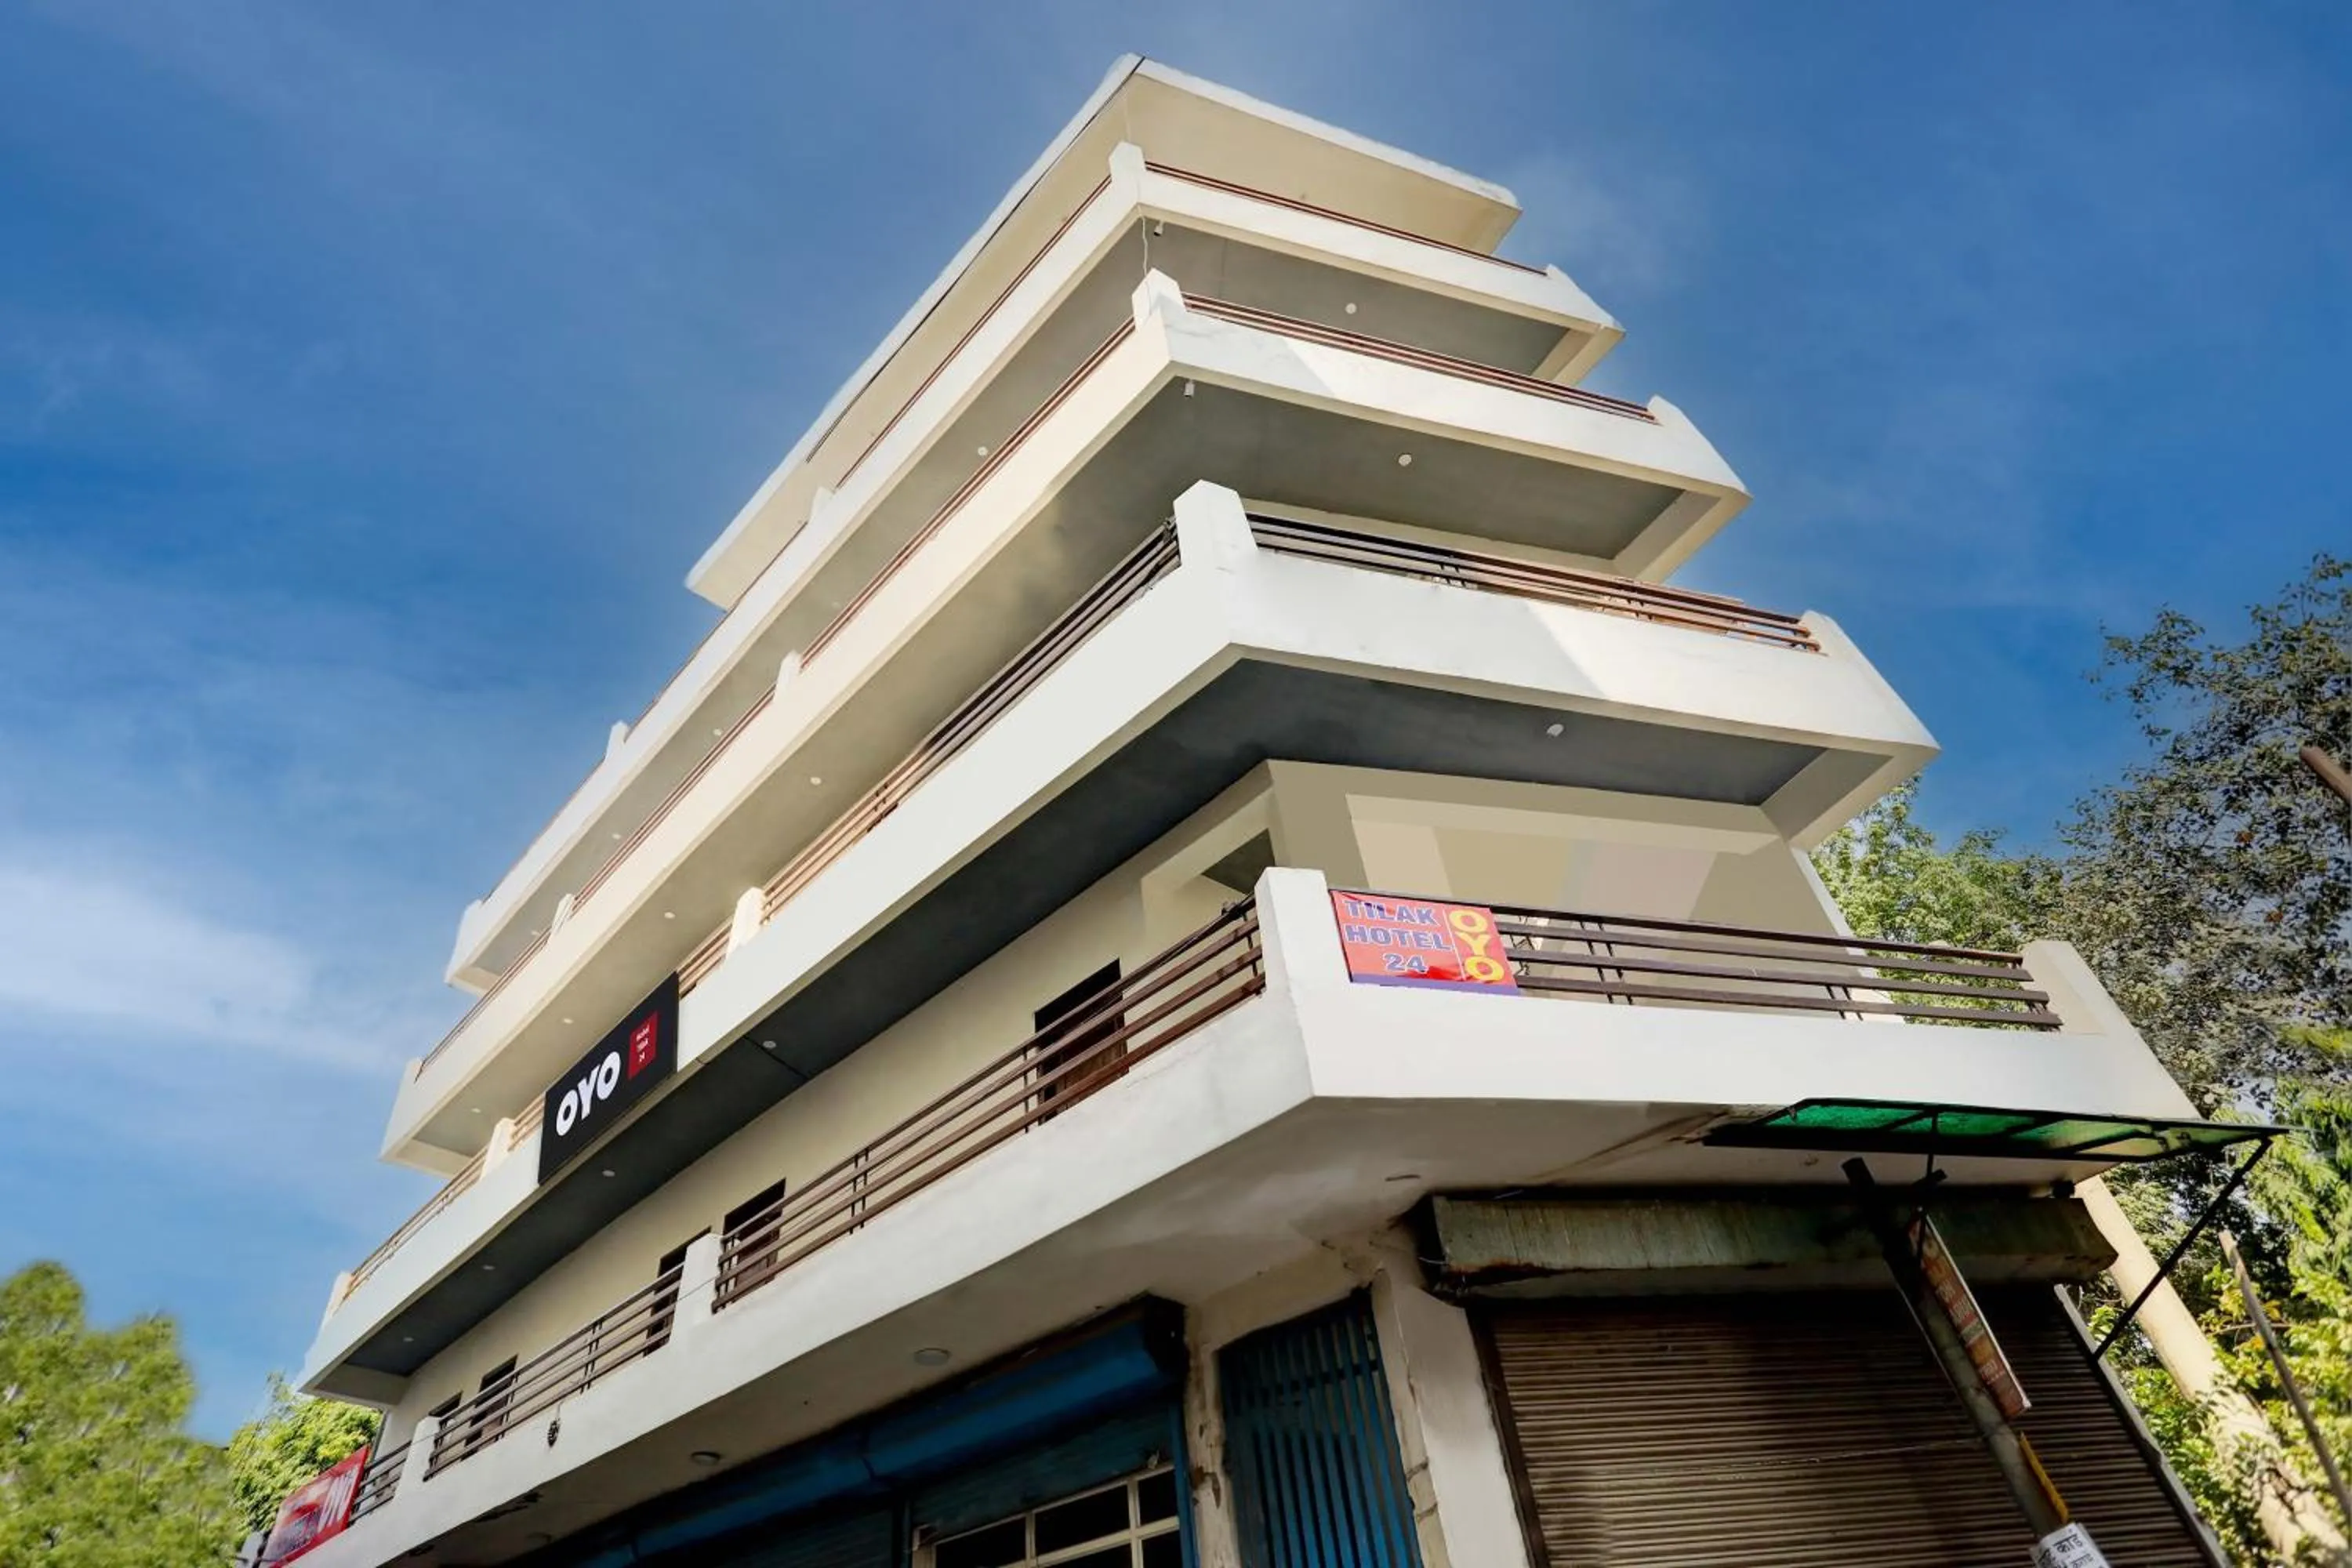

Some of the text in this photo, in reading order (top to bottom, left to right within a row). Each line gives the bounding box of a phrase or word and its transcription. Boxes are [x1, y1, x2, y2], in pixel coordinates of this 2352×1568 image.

[1344, 900, 1440, 926] TILAK
[1344, 924, 1452, 951] HOTEL
[1449, 909, 1504, 982] OYO
[1383, 953, 1428, 974] 24
[556, 1051, 621, 1136] OYO
